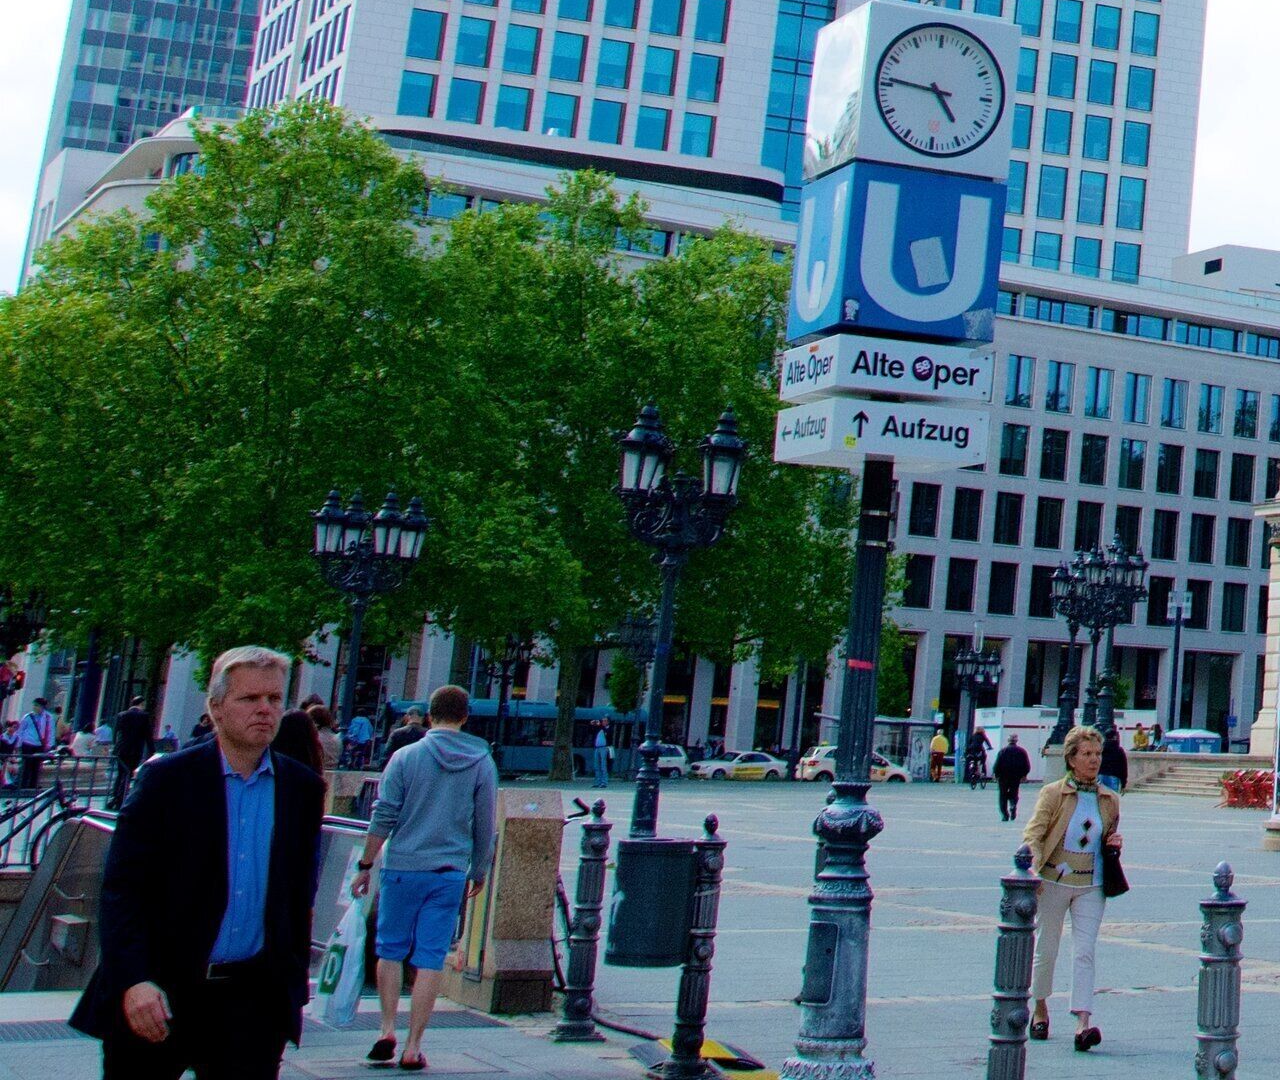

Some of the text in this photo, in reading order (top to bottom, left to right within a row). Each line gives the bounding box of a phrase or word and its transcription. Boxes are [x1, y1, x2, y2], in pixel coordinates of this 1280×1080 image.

[796, 181, 848, 322] U
[860, 180, 992, 322] U
[786, 353, 834, 386] Alte Oper
[851, 350, 905, 379] Alte
[794, 416, 827, 439] Aufzug
[882, 415, 970, 448] Aufzug
